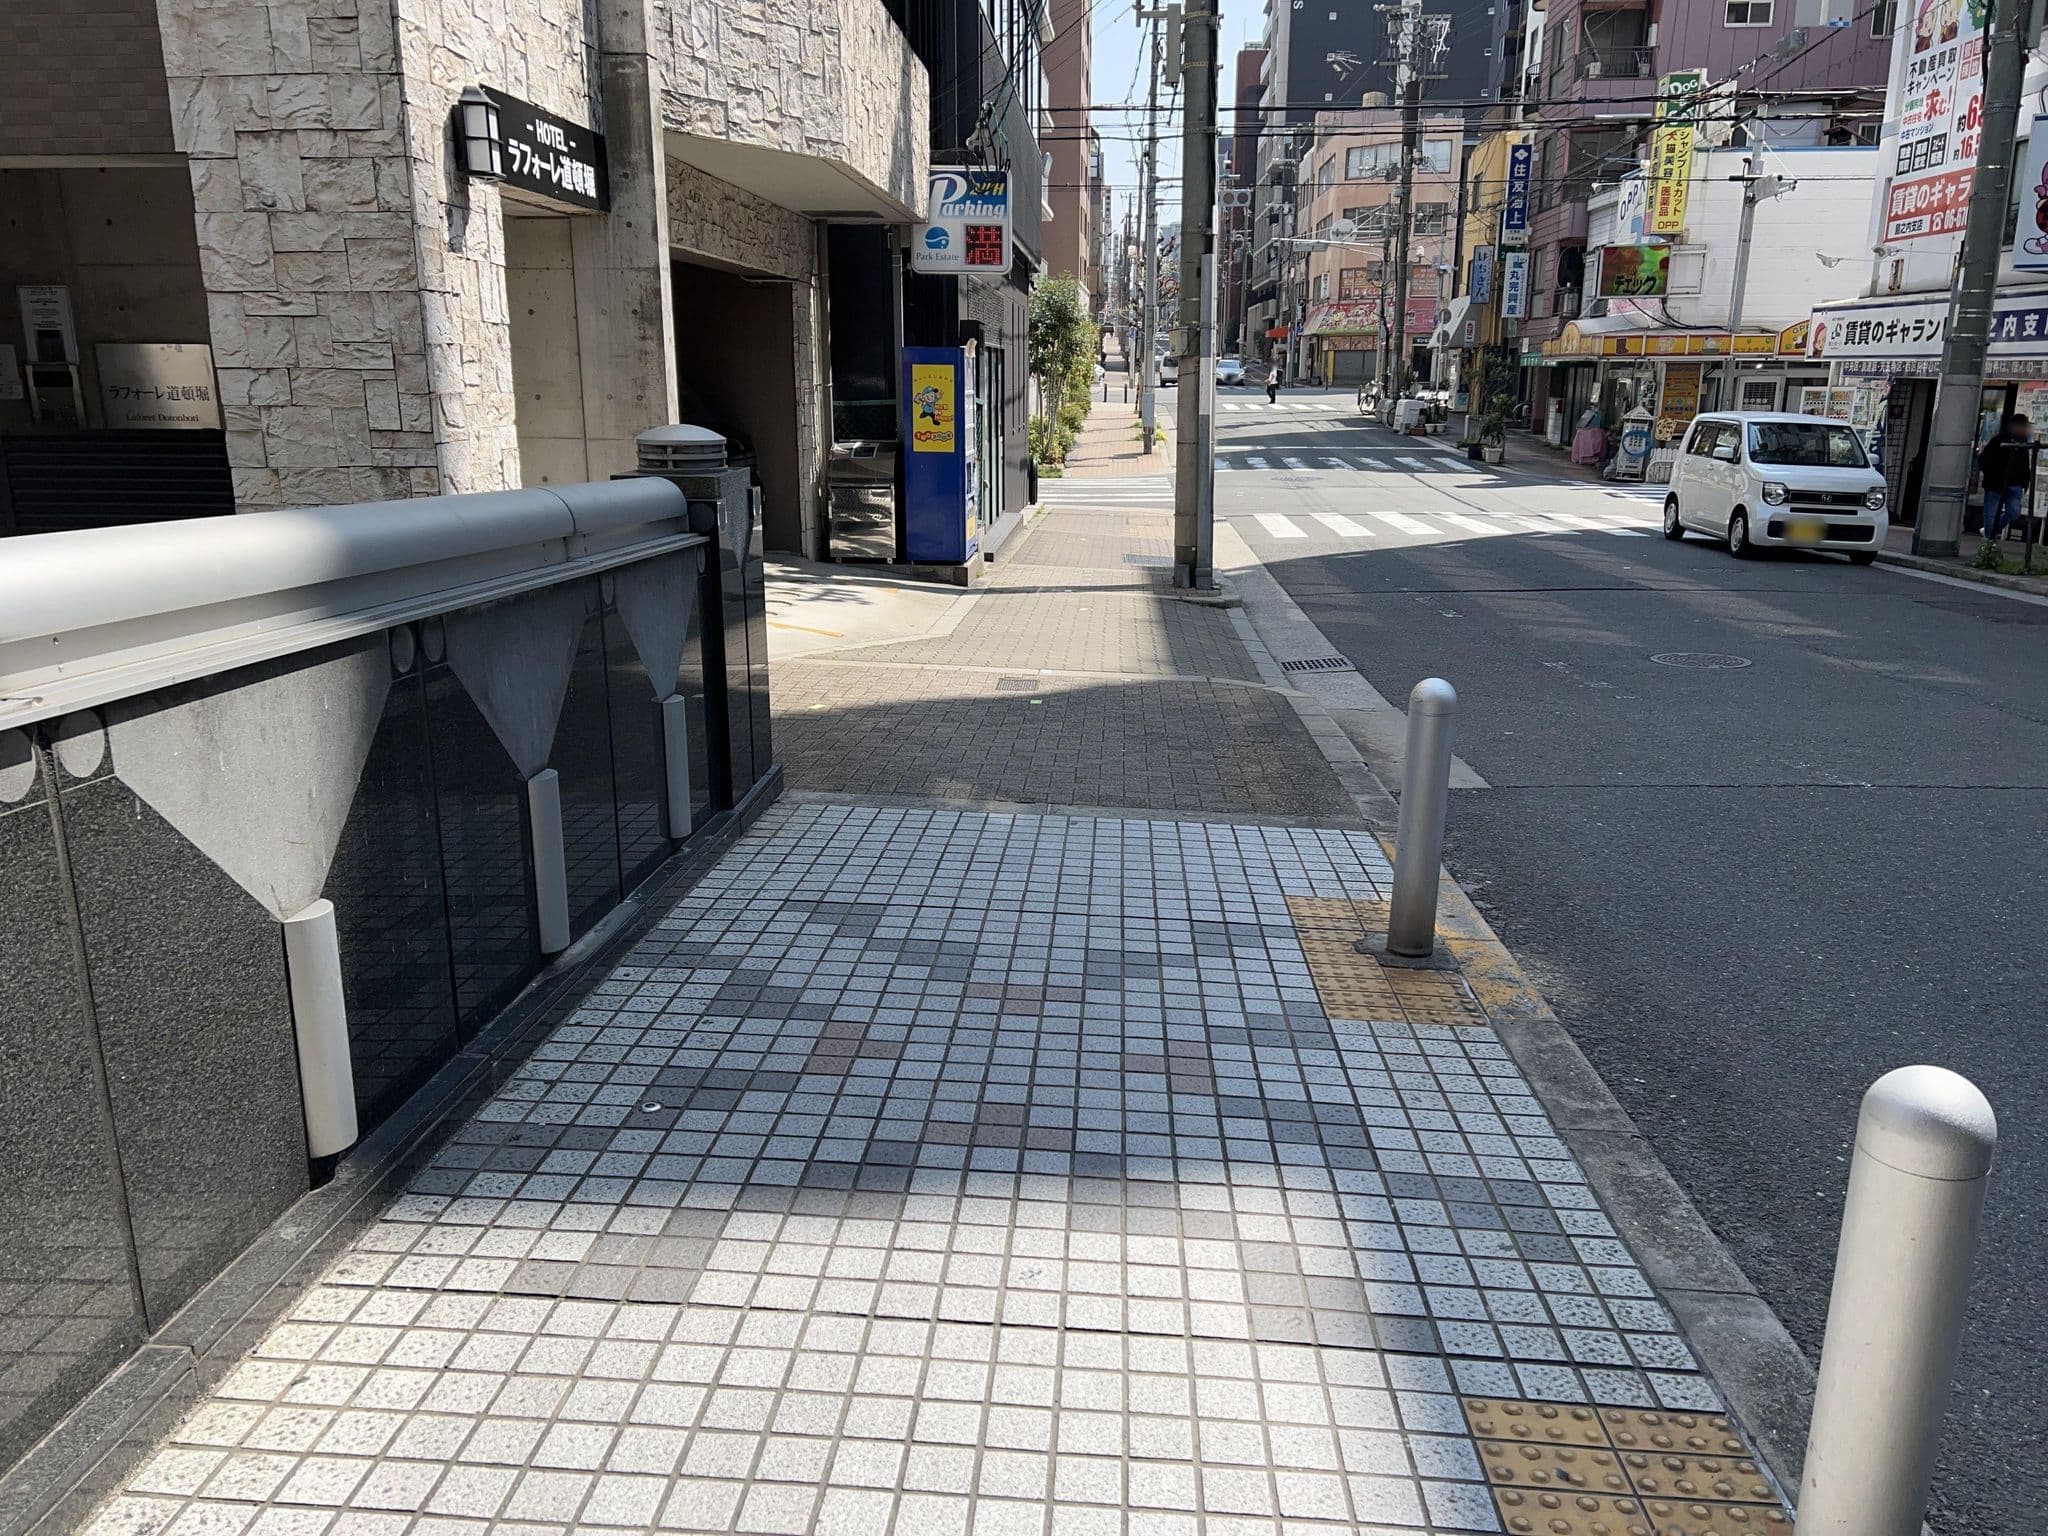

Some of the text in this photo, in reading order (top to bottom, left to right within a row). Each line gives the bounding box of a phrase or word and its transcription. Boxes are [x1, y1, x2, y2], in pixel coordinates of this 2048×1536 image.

[1909, 47, 1957, 78] 不動産買取
[1669, 79, 1698, 95] DOG
[1907, 67, 1955, 95] キャンペーン
[536, 119, 568, 152] HOTEL
[1900, 122, 1935, 140] 中古マンション
[507, 138, 597, 199] ラフォーレ道頓堀
[929, 173, 1006, 219] Parking
[1890, 175, 1972, 216] 賃貸のギャラ
[1657, 220, 1679, 230] OPP
[916, 252, 959, 261] Park Estate
[1988, 312, 2048, 338] 之内支
[108, 385, 210, 402] ラフォーレ道頓堀
